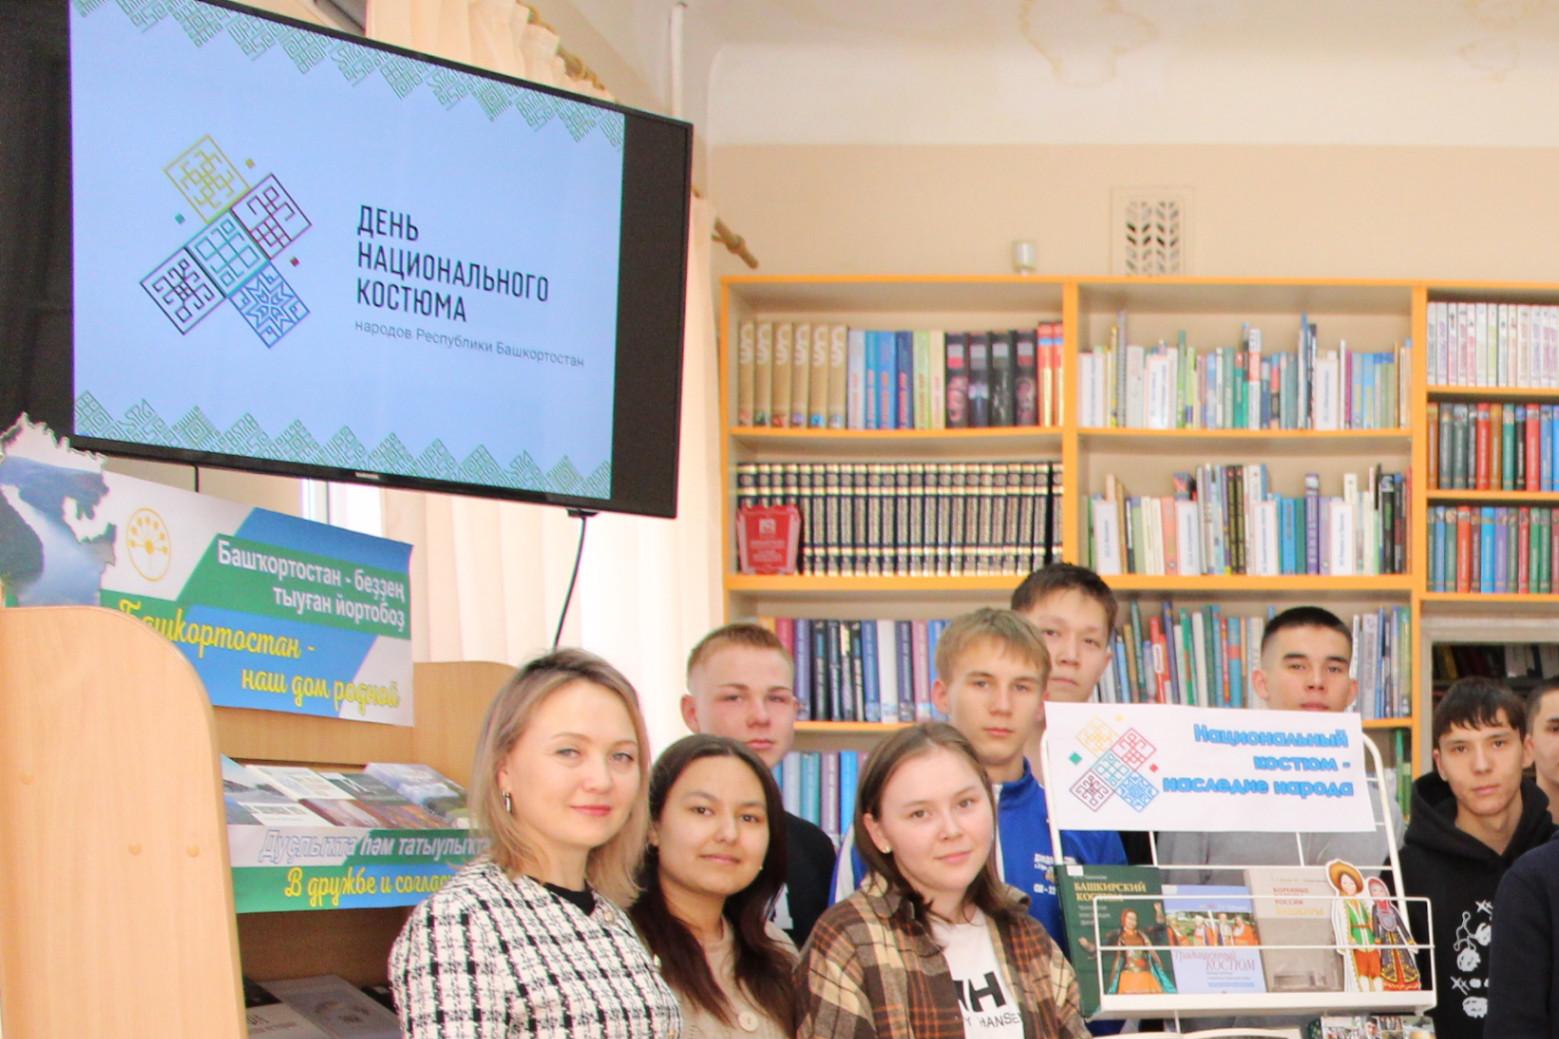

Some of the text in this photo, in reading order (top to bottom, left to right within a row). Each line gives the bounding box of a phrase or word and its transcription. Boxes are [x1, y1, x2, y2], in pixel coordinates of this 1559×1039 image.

[357, 204, 419, 242] ДЕНЬ
[357, 241, 549, 302] НАЦИОНАЛЬНОГО
[357, 277, 467, 323] КОСТЮМА
[355, 320, 584, 367] народов Республики Башкортостан
[241, 668, 400, 716] наш дом родной
[1193, 723, 1349, 748] Национальный
[1162, 777, 1354, 799] наследие народа
[283, 867, 303, 896] В
[307, 867, 377, 907] дружбе
[381, 874, 392, 893] и
[1073, 880, 1147, 893] БАШКИРСКИЙ
